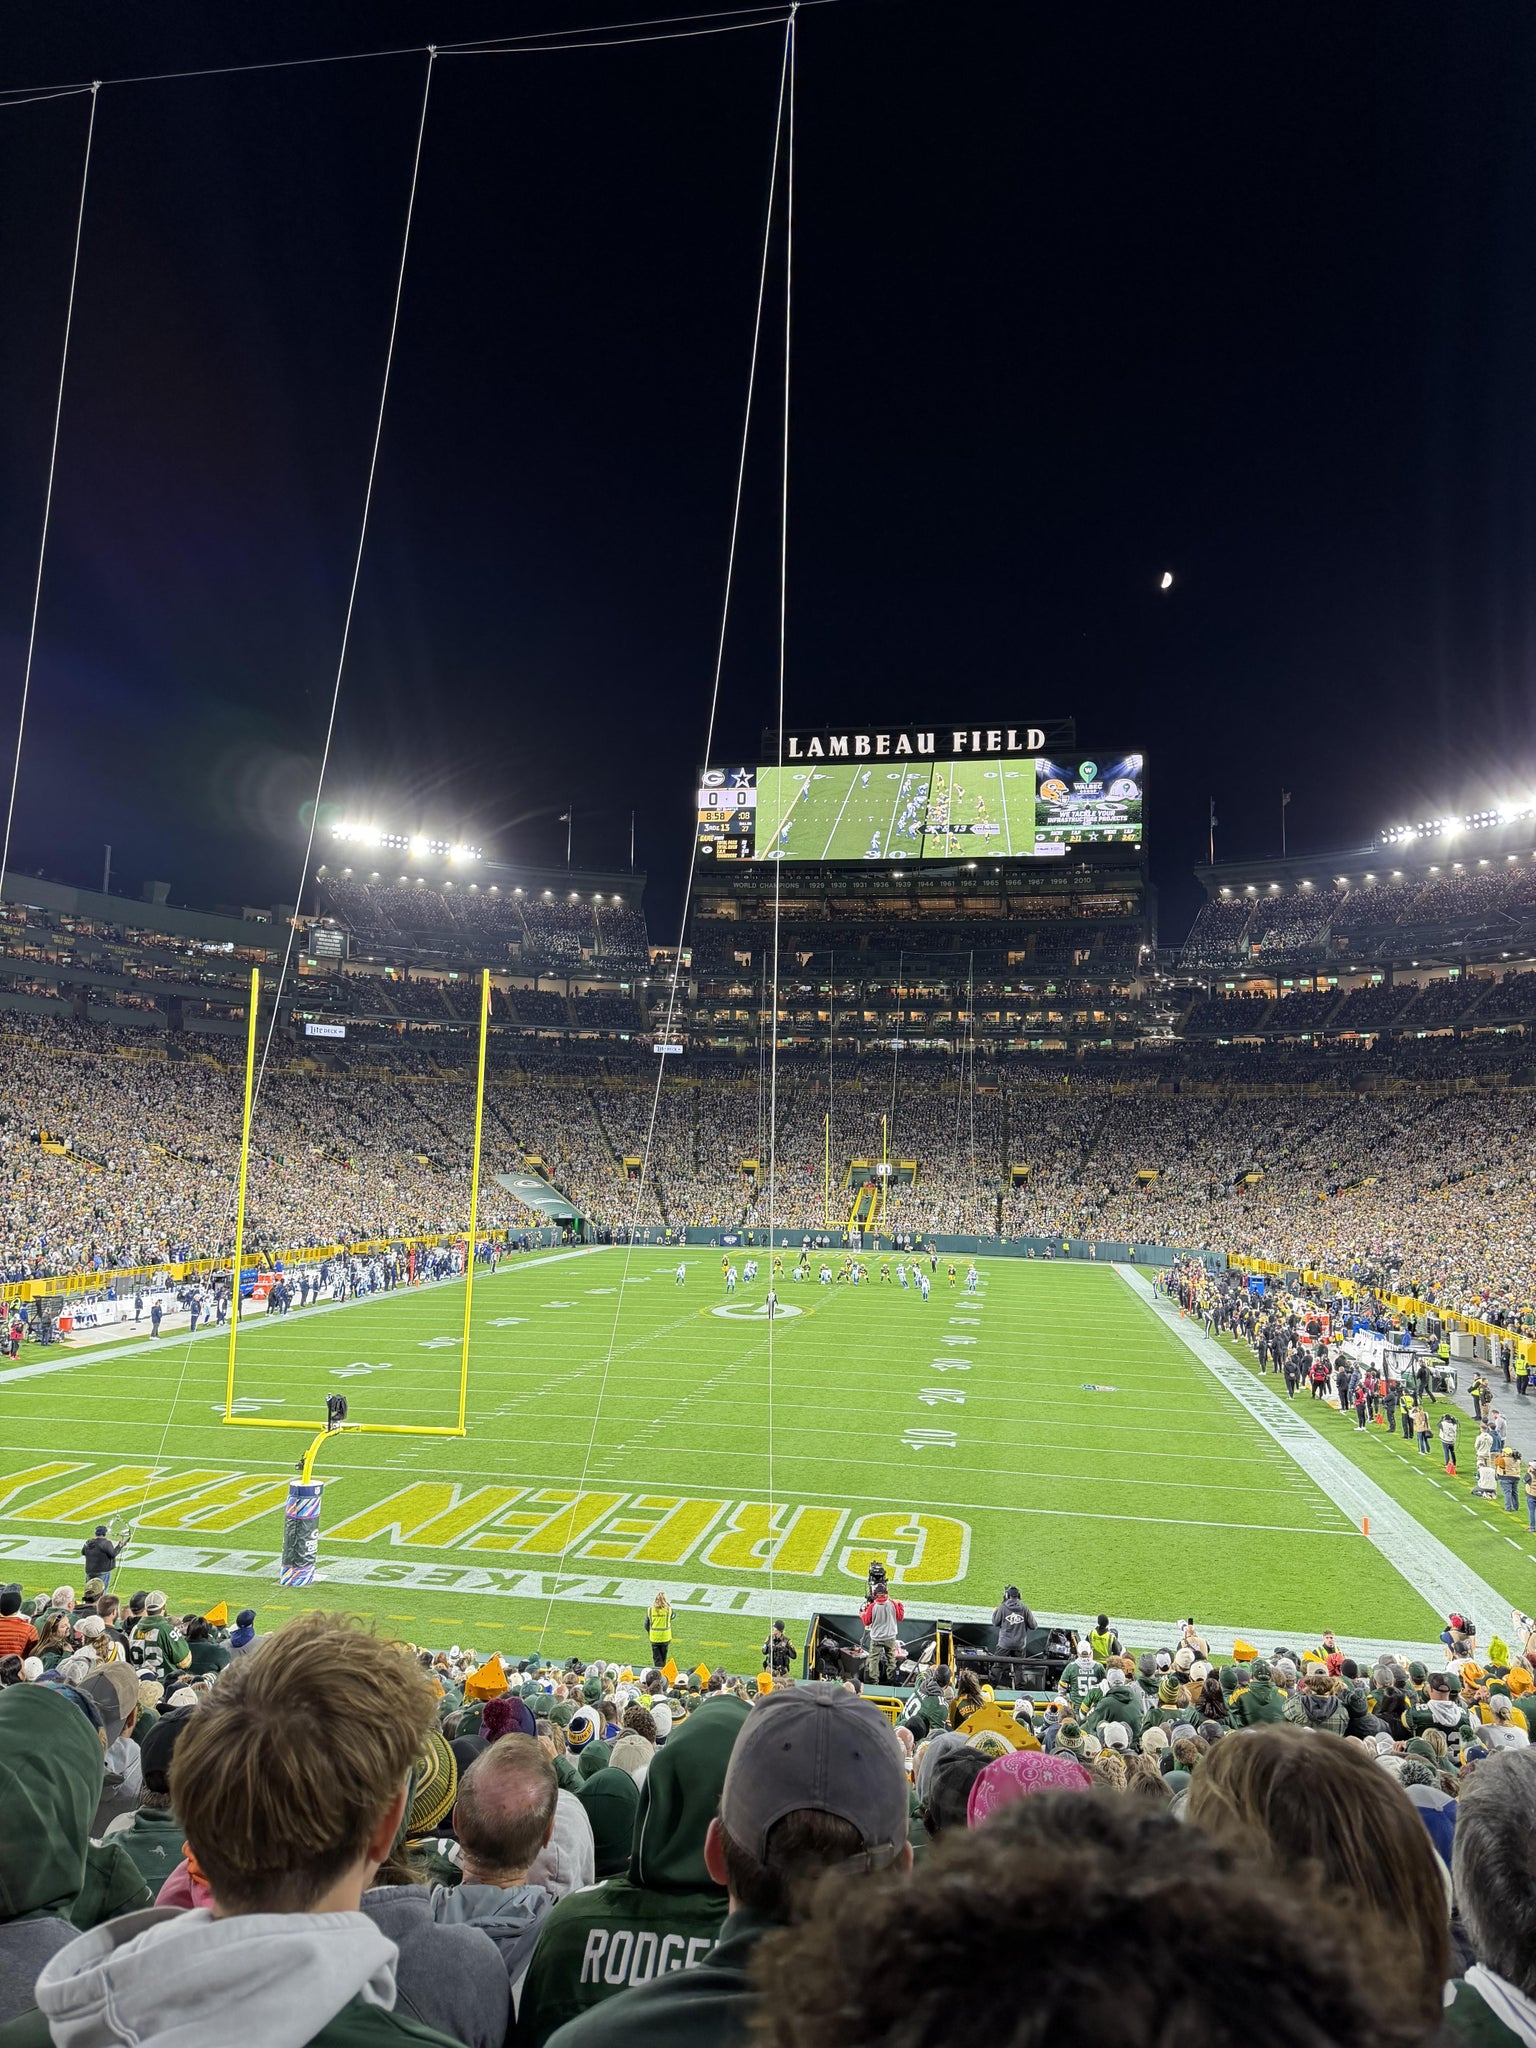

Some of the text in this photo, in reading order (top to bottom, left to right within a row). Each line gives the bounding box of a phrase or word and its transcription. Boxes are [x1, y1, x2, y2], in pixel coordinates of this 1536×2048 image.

[788, 728, 1046, 758] LAMBEAU FIELD
[709, 792, 746, 806] 0 0
[706, 812, 725, 821] 8:58
[720, 823, 730, 832] 13
[760, 881, 800, 889] CHAMPIONS
[809, 881, 825, 889] 1929
[831, 881, 847, 889] 1930
[853, 881, 867, 889] 1931
[918, 880, 934, 888] 1944
[960, 879, 977, 887] 1962
[1028, 878, 1045, 886] 1967
[310, 1025, 323, 1034] Lite
[900, 1428, 958, 1448] 10
[318, 1480, 972, 1586] GREEN
[362, 1563, 624, 1600] TAKES
[669, 1587, 751, 1610] IT
[579, 1928, 720, 1987] RODGE
